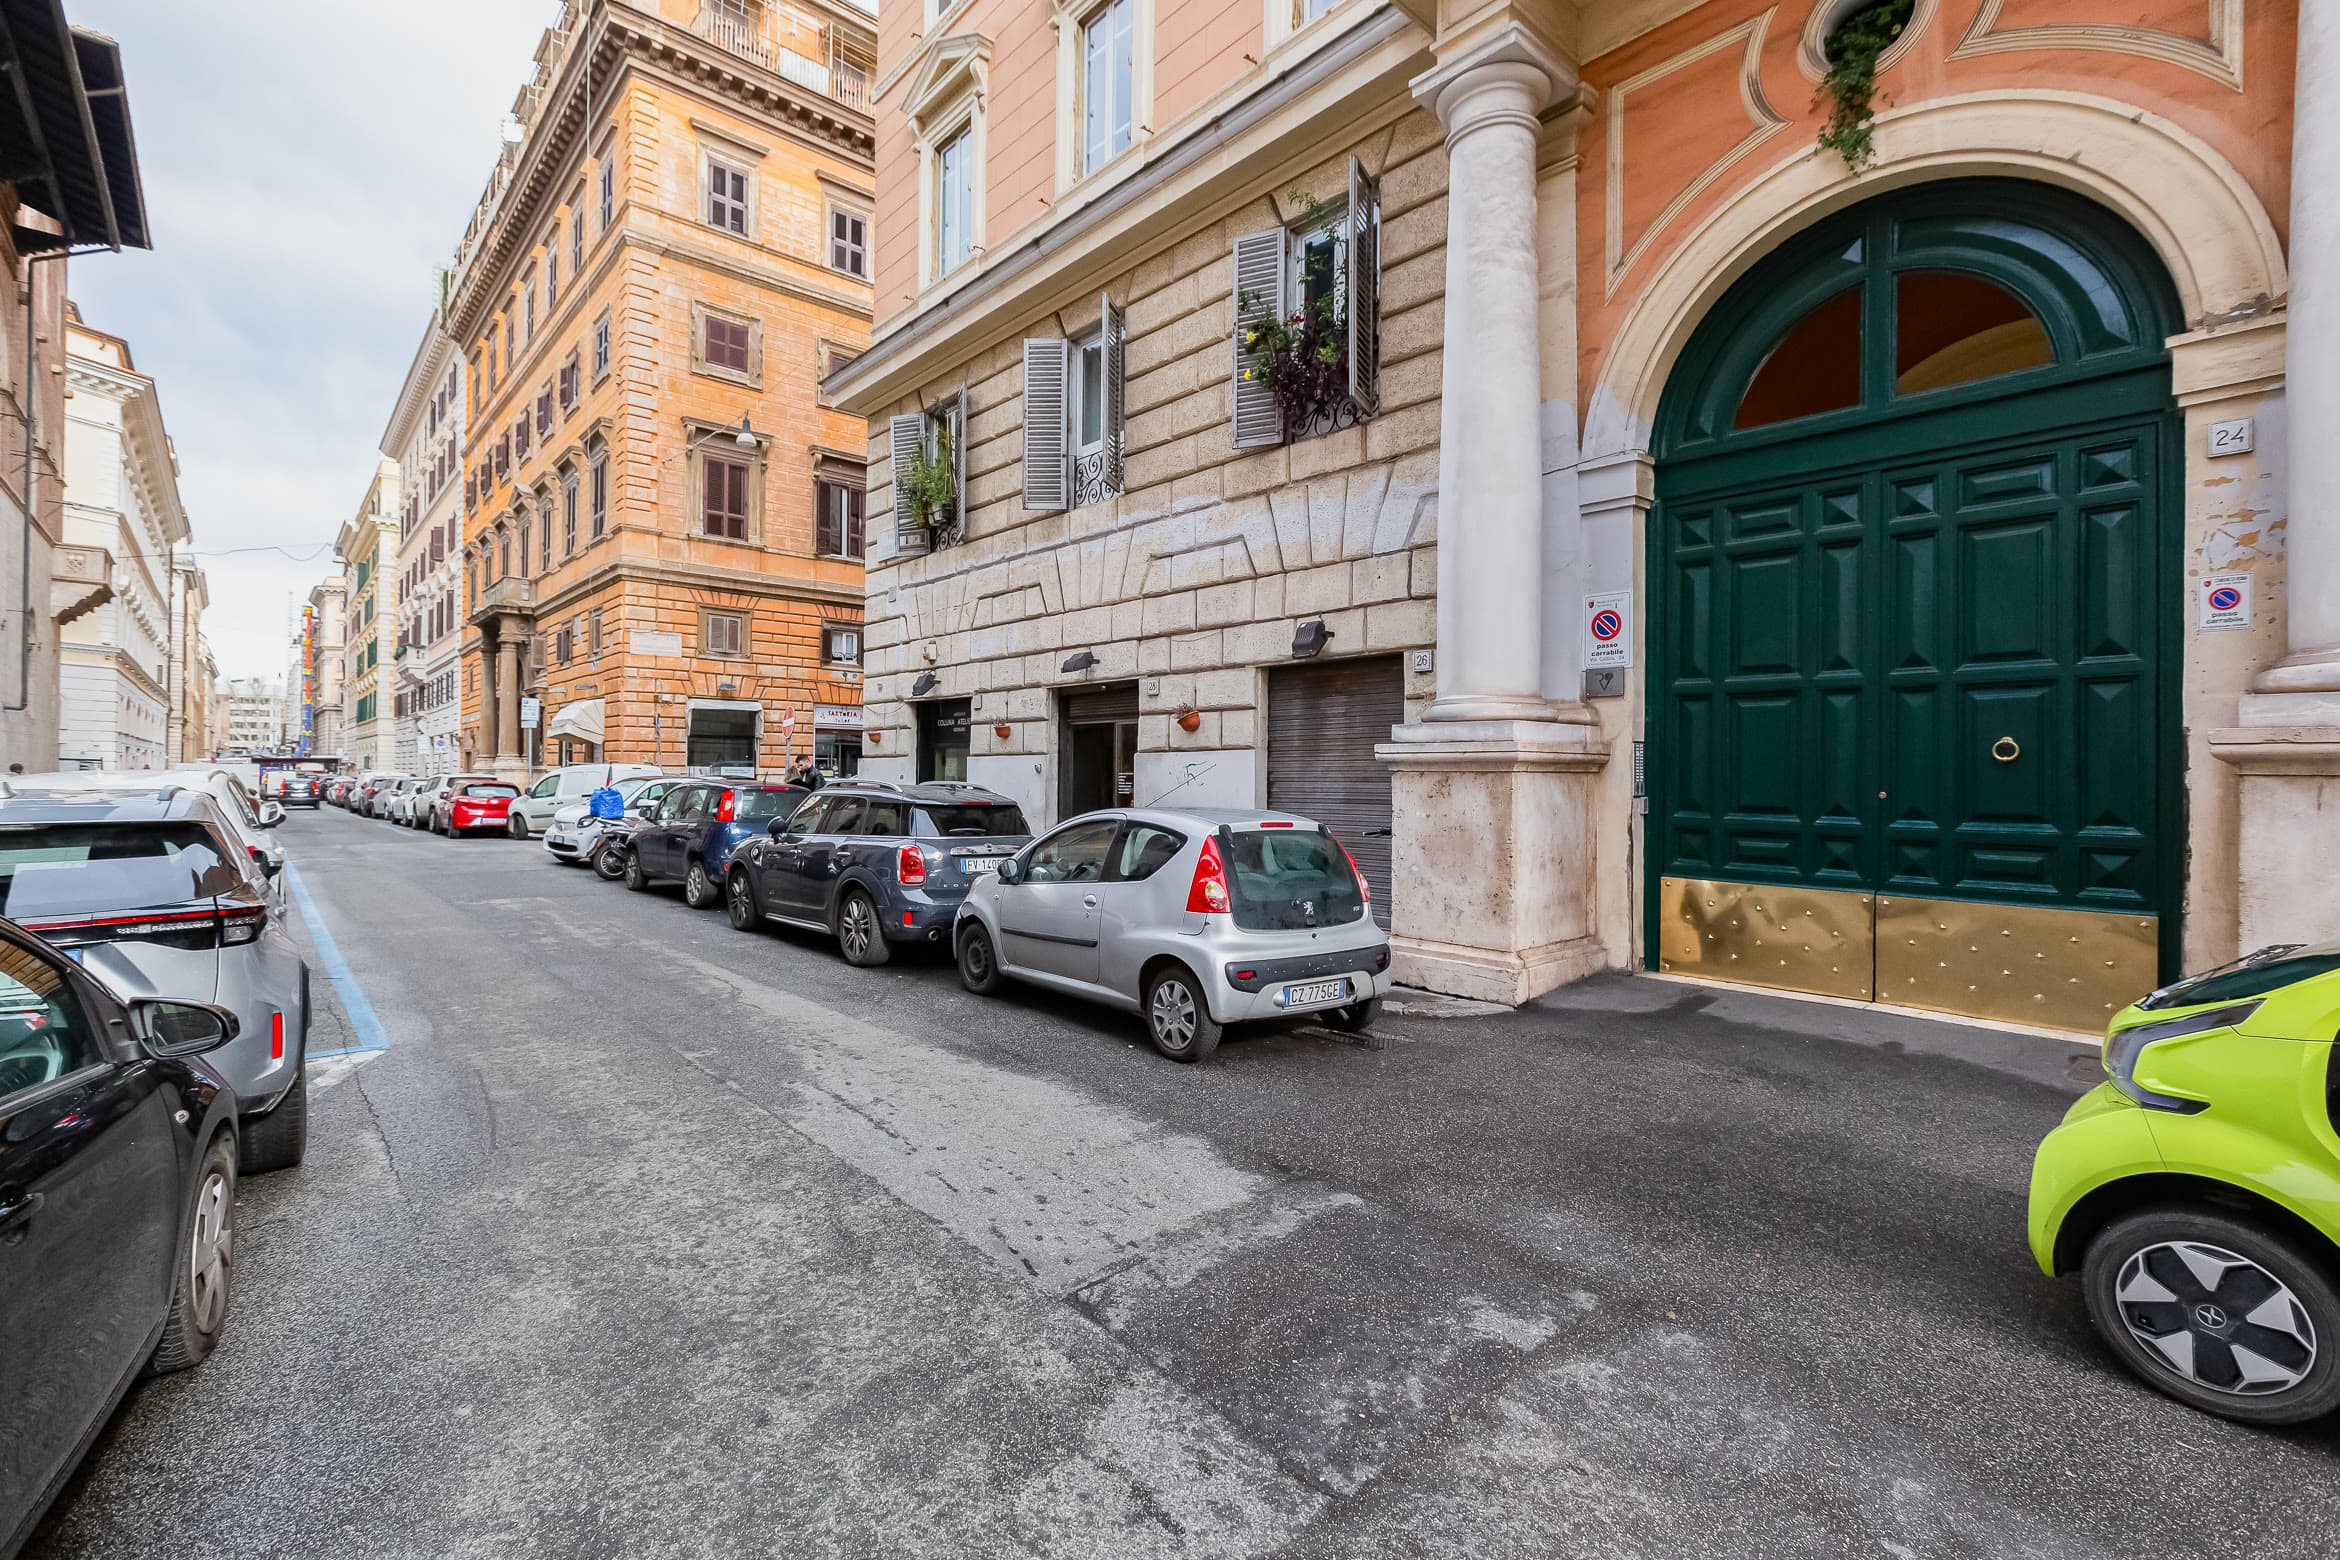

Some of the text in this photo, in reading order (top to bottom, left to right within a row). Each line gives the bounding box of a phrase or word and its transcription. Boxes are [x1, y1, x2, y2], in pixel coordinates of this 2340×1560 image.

[2215, 426, 2244, 447] 24
[1596, 642, 1618, 650] passo
[1591, 648, 1624, 657] carrabile
[1416, 654, 1428, 666] 26
[1291, 982, 1339, 1003] CZ 775GE
